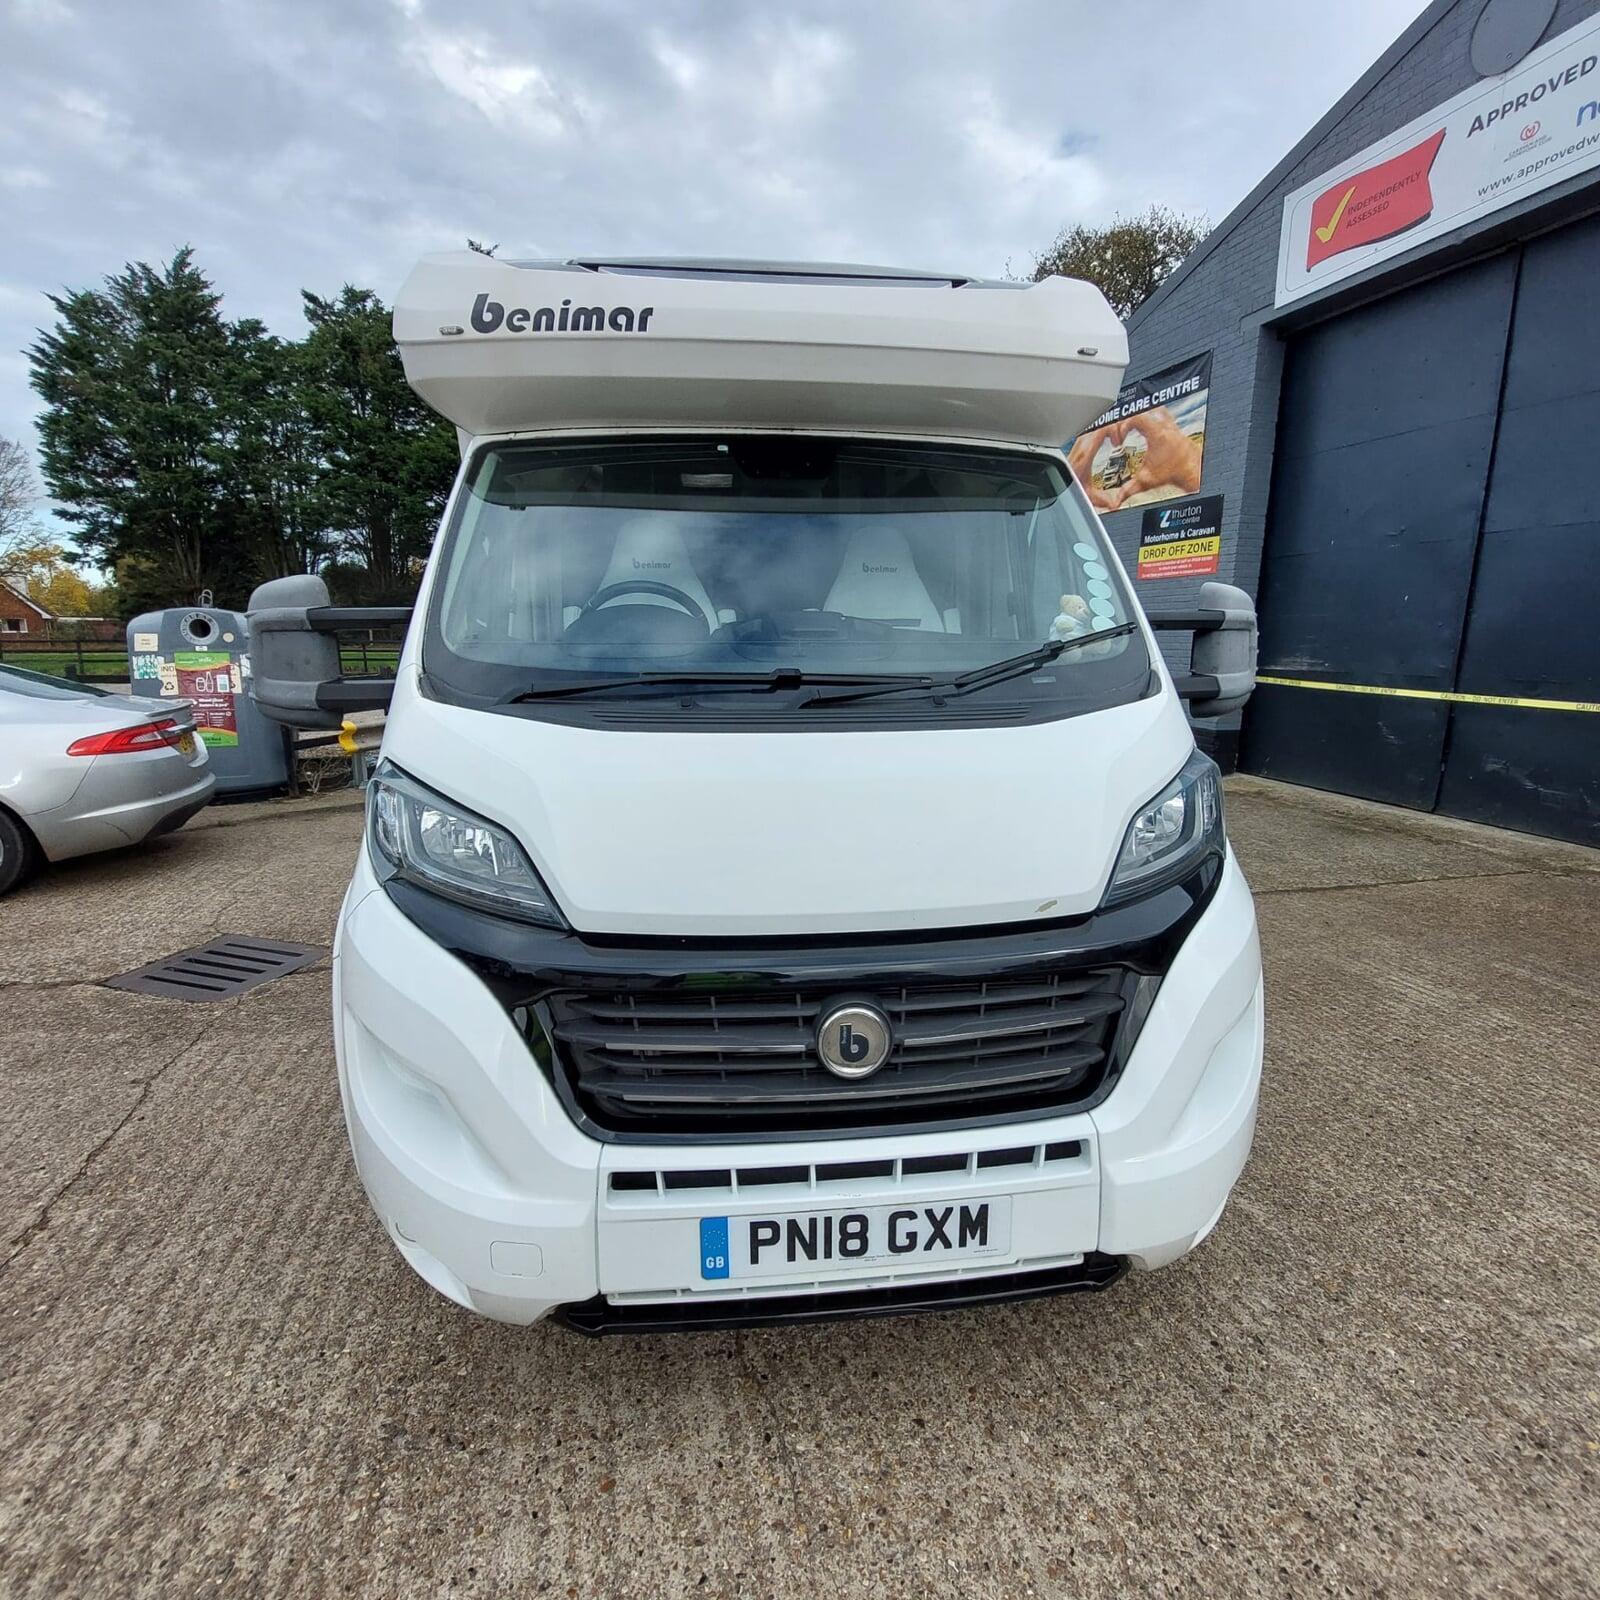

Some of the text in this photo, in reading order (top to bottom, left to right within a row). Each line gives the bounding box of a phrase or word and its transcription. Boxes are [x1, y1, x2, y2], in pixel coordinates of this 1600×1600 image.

[1467, 55, 1598, 139] APPROVED
[1347, 170, 1422, 215] INDEPENDENTLY
[1346, 200, 1390, 229] ASSESSED
[470, 293, 654, 334] benimar
[1121, 396, 1151, 416] CARE
[1152, 376, 1200, 405] CENTRE
[1143, 541, 1214, 560] DROP OFF ZONE
[1144, 526, 1216, 544] Motorhome & Caravan
[749, 1203, 989, 1265] PN18 GXM
[705, 1256, 725, 1270] GB
